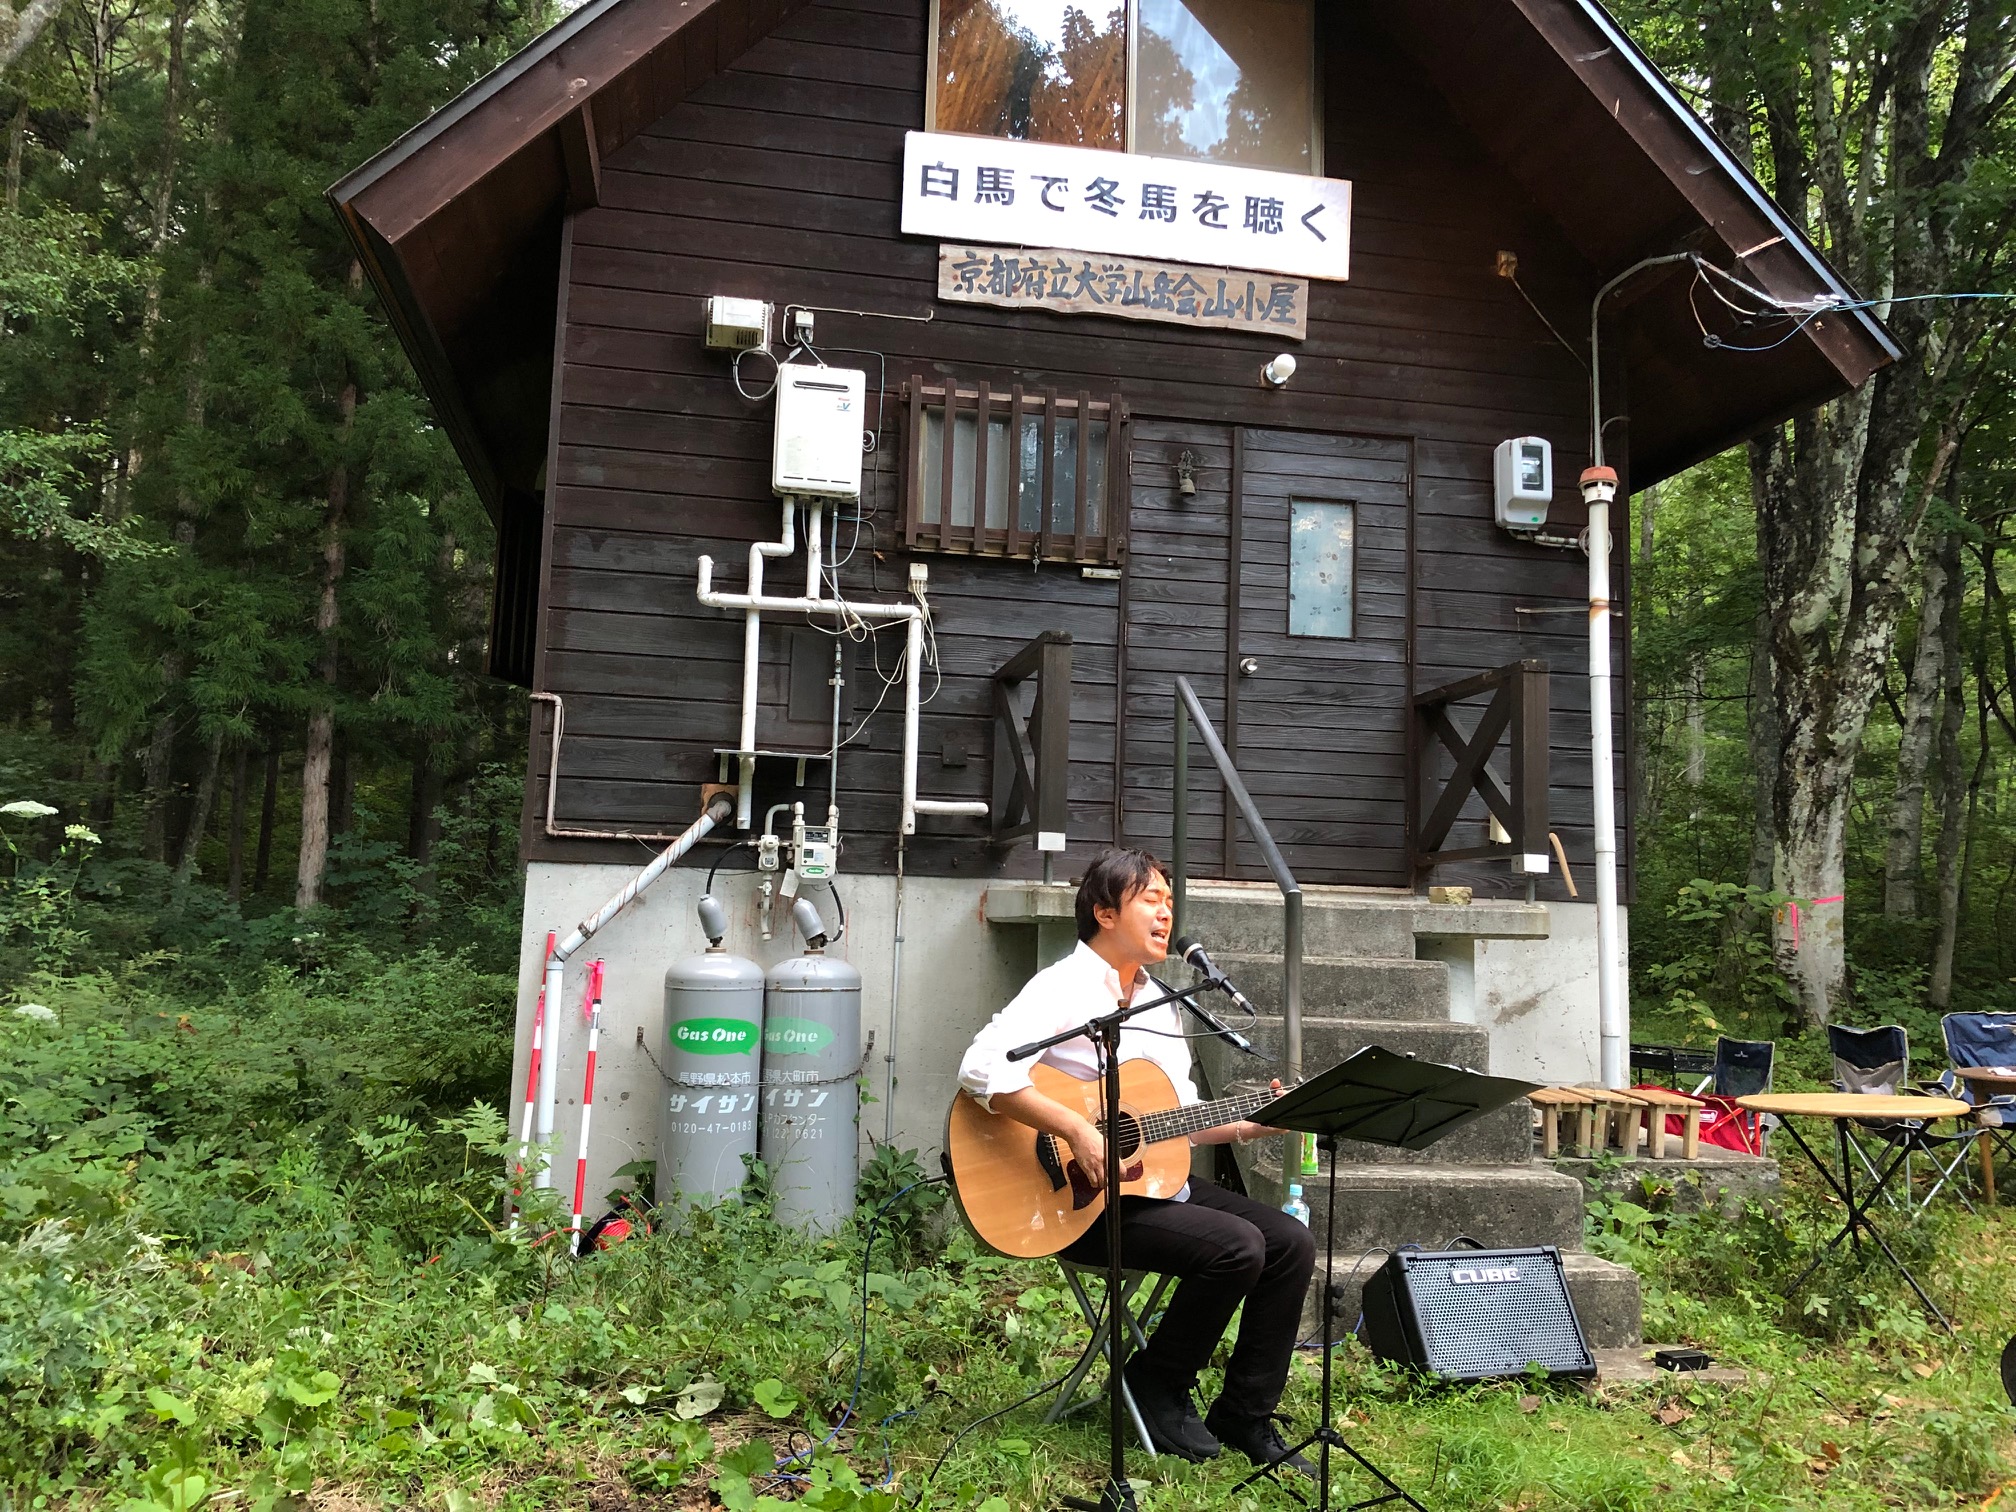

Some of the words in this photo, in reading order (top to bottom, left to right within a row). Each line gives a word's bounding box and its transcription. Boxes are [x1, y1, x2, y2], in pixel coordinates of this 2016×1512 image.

[920, 160, 1328, 243] 白馬で冬馬を聴く
[952, 251, 1299, 325] 京都府立大学山岳会山小屋
[677, 1026, 709, 1042] Gas
[711, 1027, 747, 1043] One
[783, 1028, 819, 1043] One
[679, 1071, 752, 1086] 長野県松本市
[669, 1093, 756, 1114] サイサン
[671, 1120, 752, 1134] 0120-47-0183
[1452, 1267, 1521, 1284] CUBE
